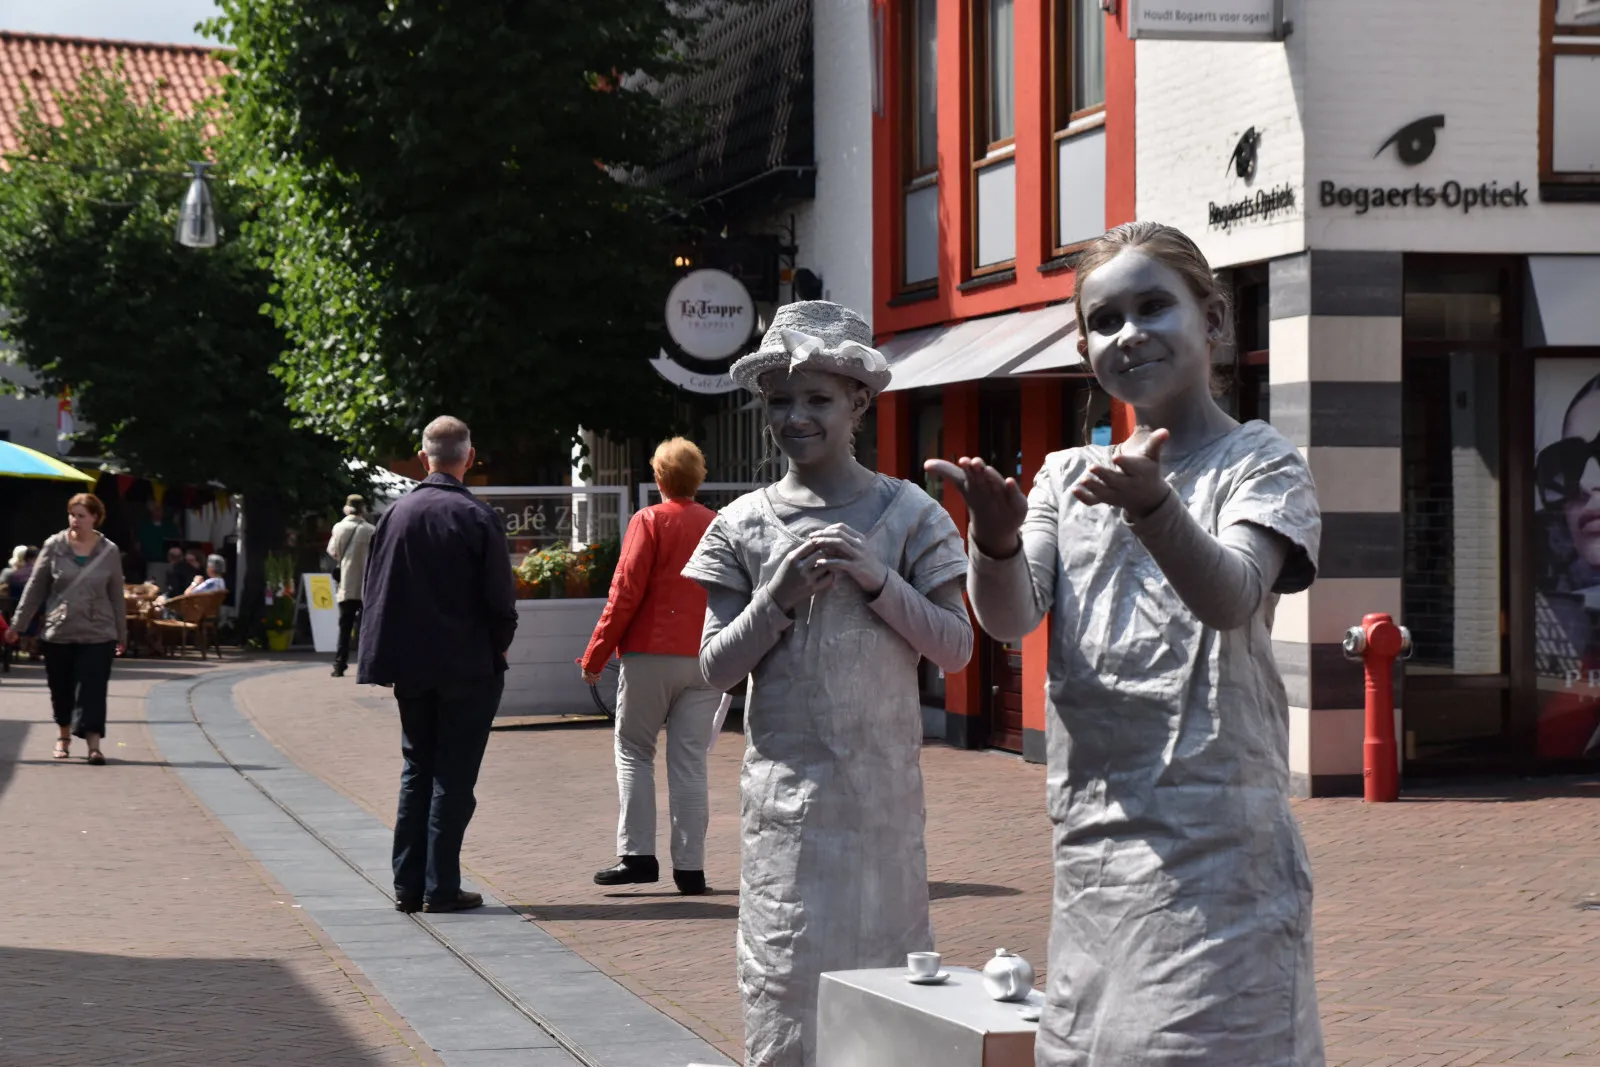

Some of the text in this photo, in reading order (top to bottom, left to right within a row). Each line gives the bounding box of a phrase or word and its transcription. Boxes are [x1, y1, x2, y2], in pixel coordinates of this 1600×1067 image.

[1175, 9, 1218, 24] Bogaerts
[1219, 12, 1240, 22] voor
[678, 299, 743, 319] La Trappe
[493, 505, 546, 530] afé
